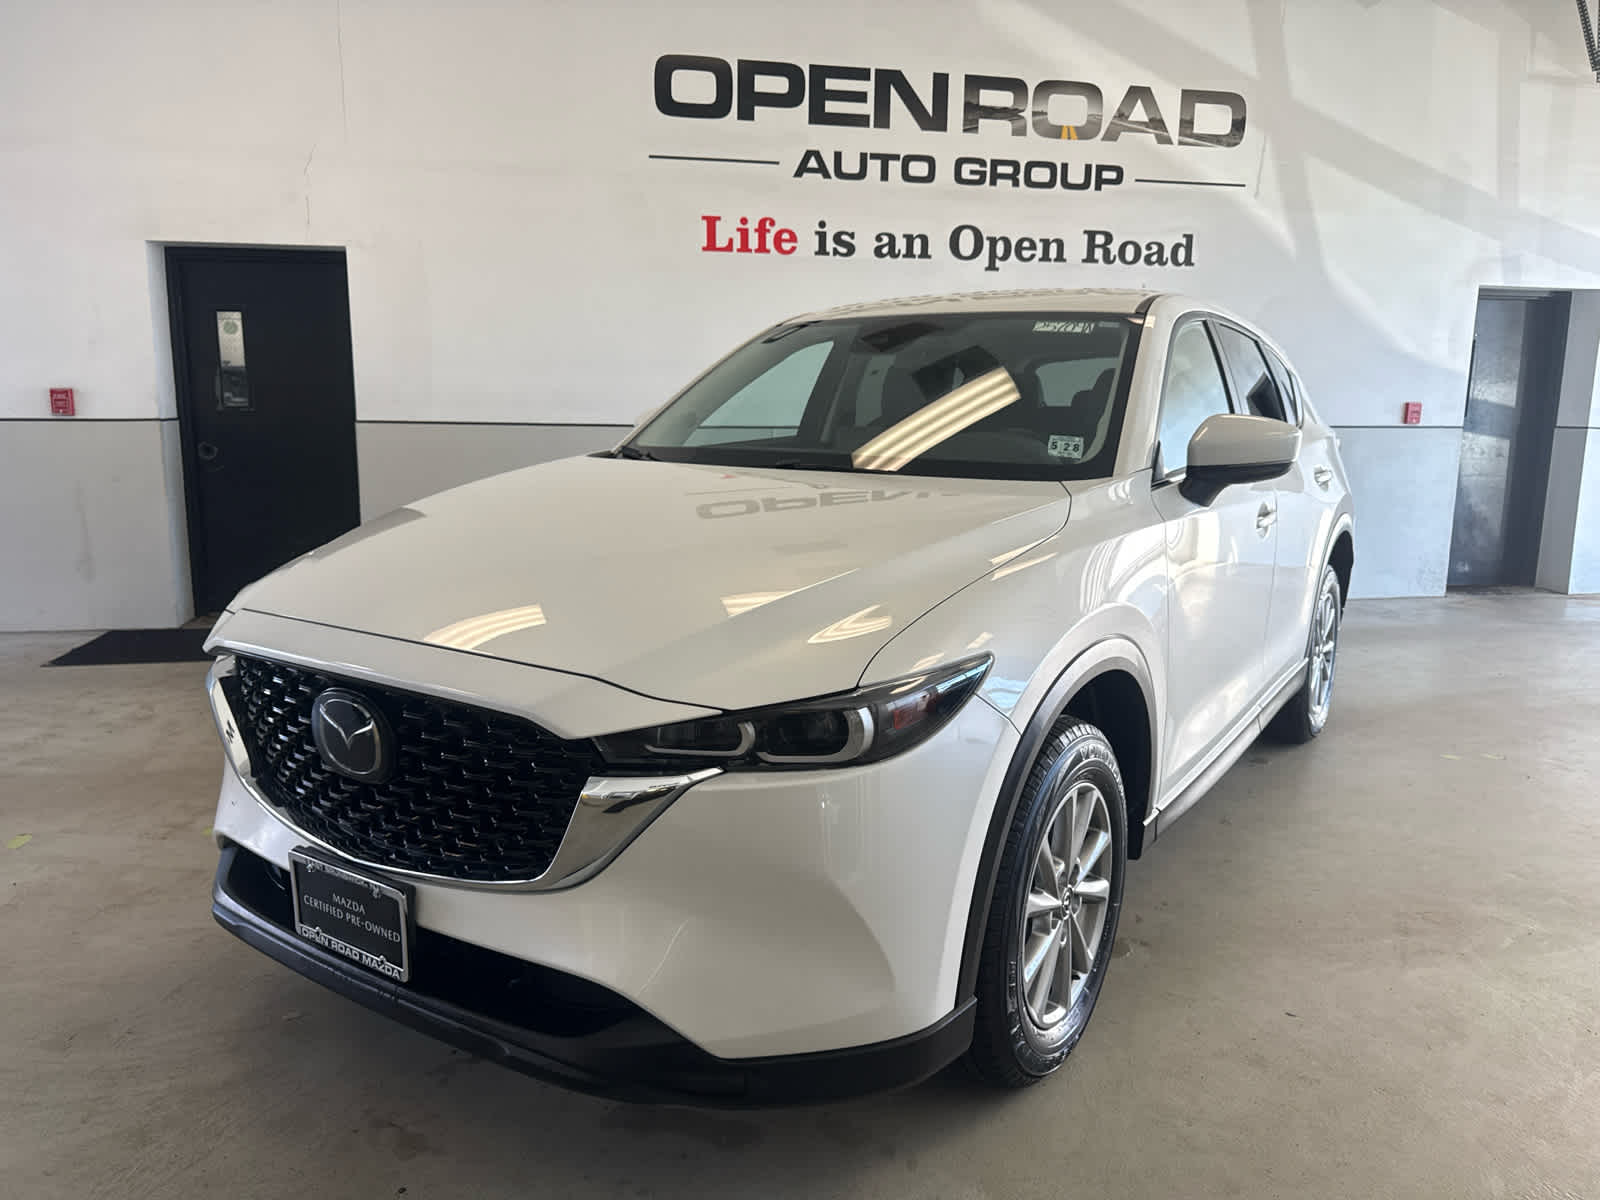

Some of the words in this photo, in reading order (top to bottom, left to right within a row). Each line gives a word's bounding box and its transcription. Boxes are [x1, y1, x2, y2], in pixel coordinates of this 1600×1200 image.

[653, 54, 949, 133] OPEN
[962, 74, 1247, 148] ROAD
[792, 149, 937, 184] AUTO
[953, 156, 1124, 192] GROUP
[701, 215, 798, 256] Life
[814, 220, 856, 258] is
[873, 232, 932, 260] an
[949, 224, 1067, 272] Open
[1081, 229, 1195, 267] Road
[1051, 441, 1057, 450] 5
[303, 894, 344, 919] CERTIFIED
[345, 911, 401, 943] PRE-OWNED
[333, 893, 366, 915] MAZDA
[301, 926, 329, 947] OPEN
[331, 940, 360, 960] ROAD
[362, 953, 401, 980] MAZDA
